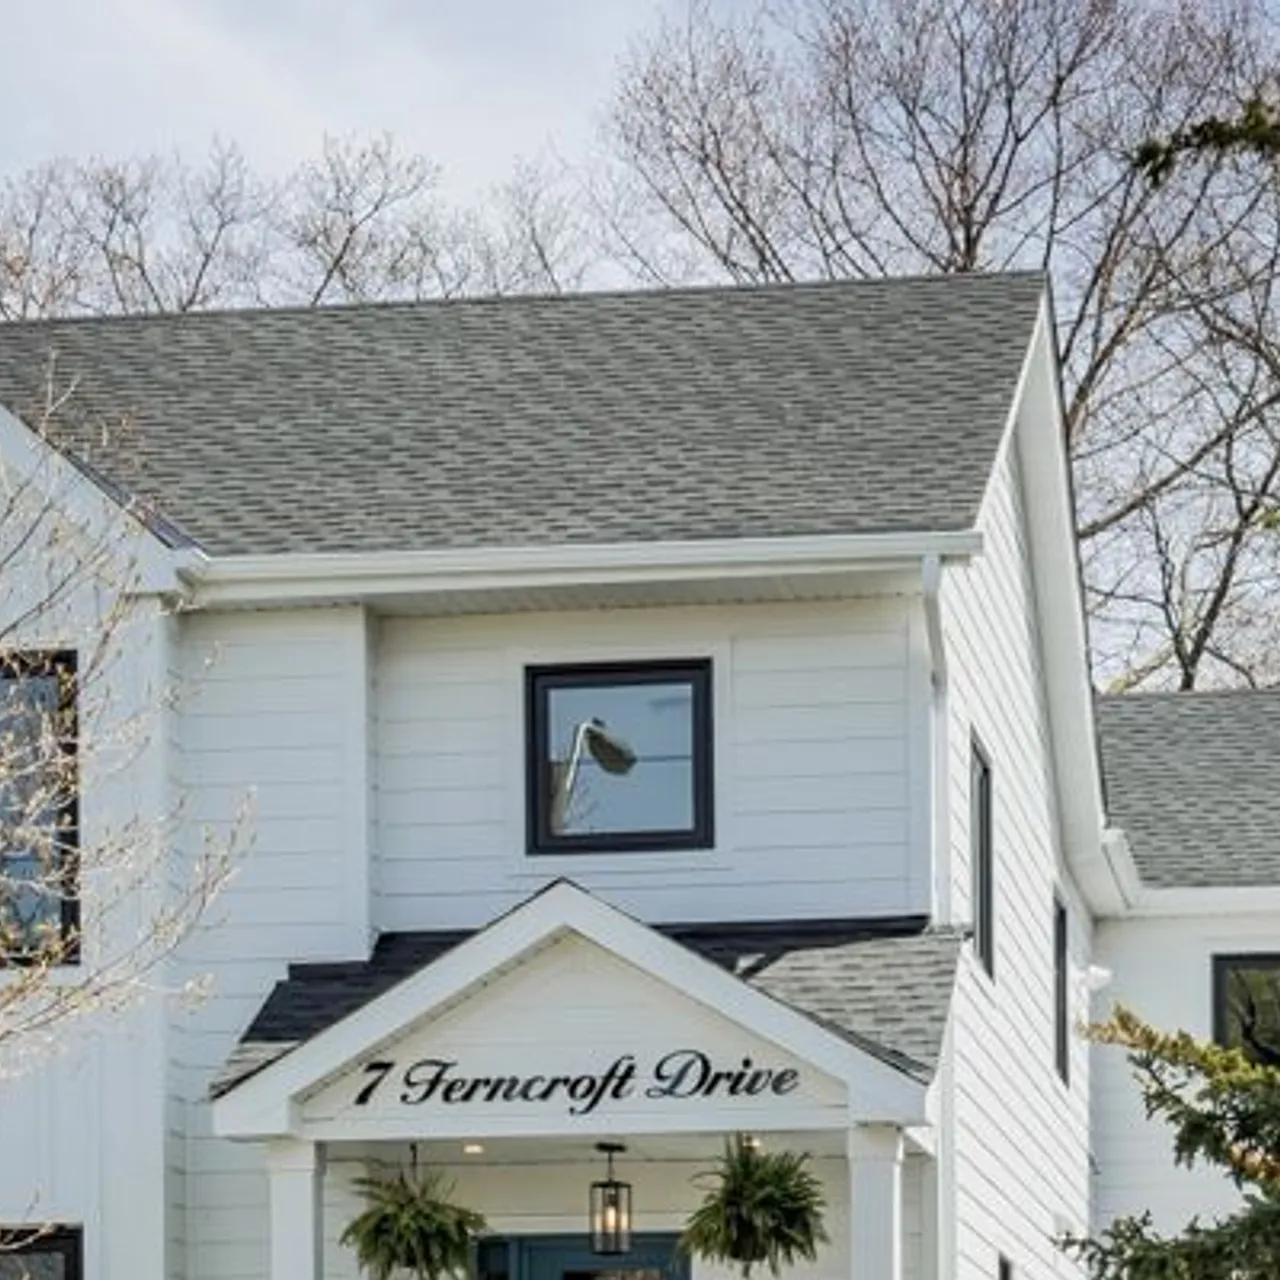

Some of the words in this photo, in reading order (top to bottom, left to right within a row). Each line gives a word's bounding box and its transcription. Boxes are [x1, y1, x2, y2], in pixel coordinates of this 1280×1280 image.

[353, 1061, 396, 1105] 7
[400, 1055, 636, 1115] Ferncroft
[645, 1049, 801, 1099] Drive
